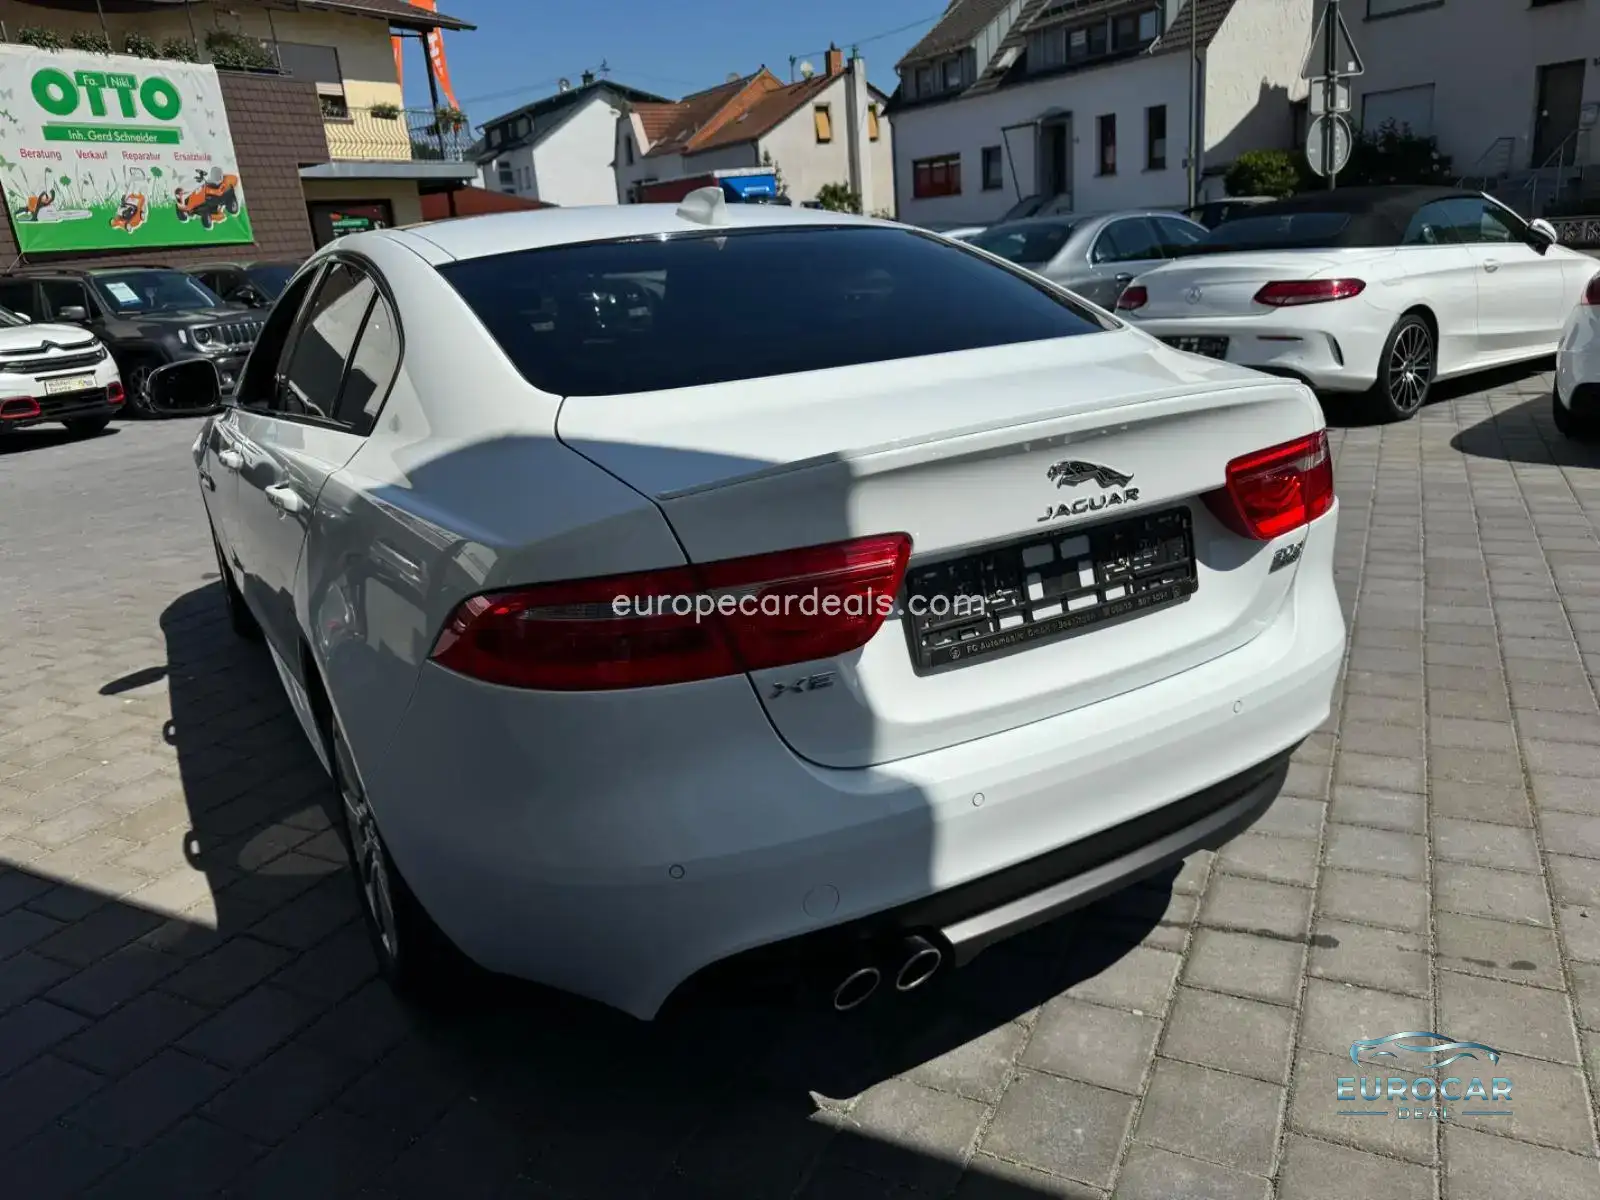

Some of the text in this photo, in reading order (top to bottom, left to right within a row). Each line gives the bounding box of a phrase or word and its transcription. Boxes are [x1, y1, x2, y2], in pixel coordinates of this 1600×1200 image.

[83, 74, 98, 86] Fa.
[31, 67, 181, 121] OTTO
[68, 129, 158, 143] Inh. Gerd Schneider
[20, 148, 212, 163] Beratung Verkauf Reparatur Ersatzteile
[1037, 487, 1140, 522] JAGUAR
[768, 671, 837, 699] XE
